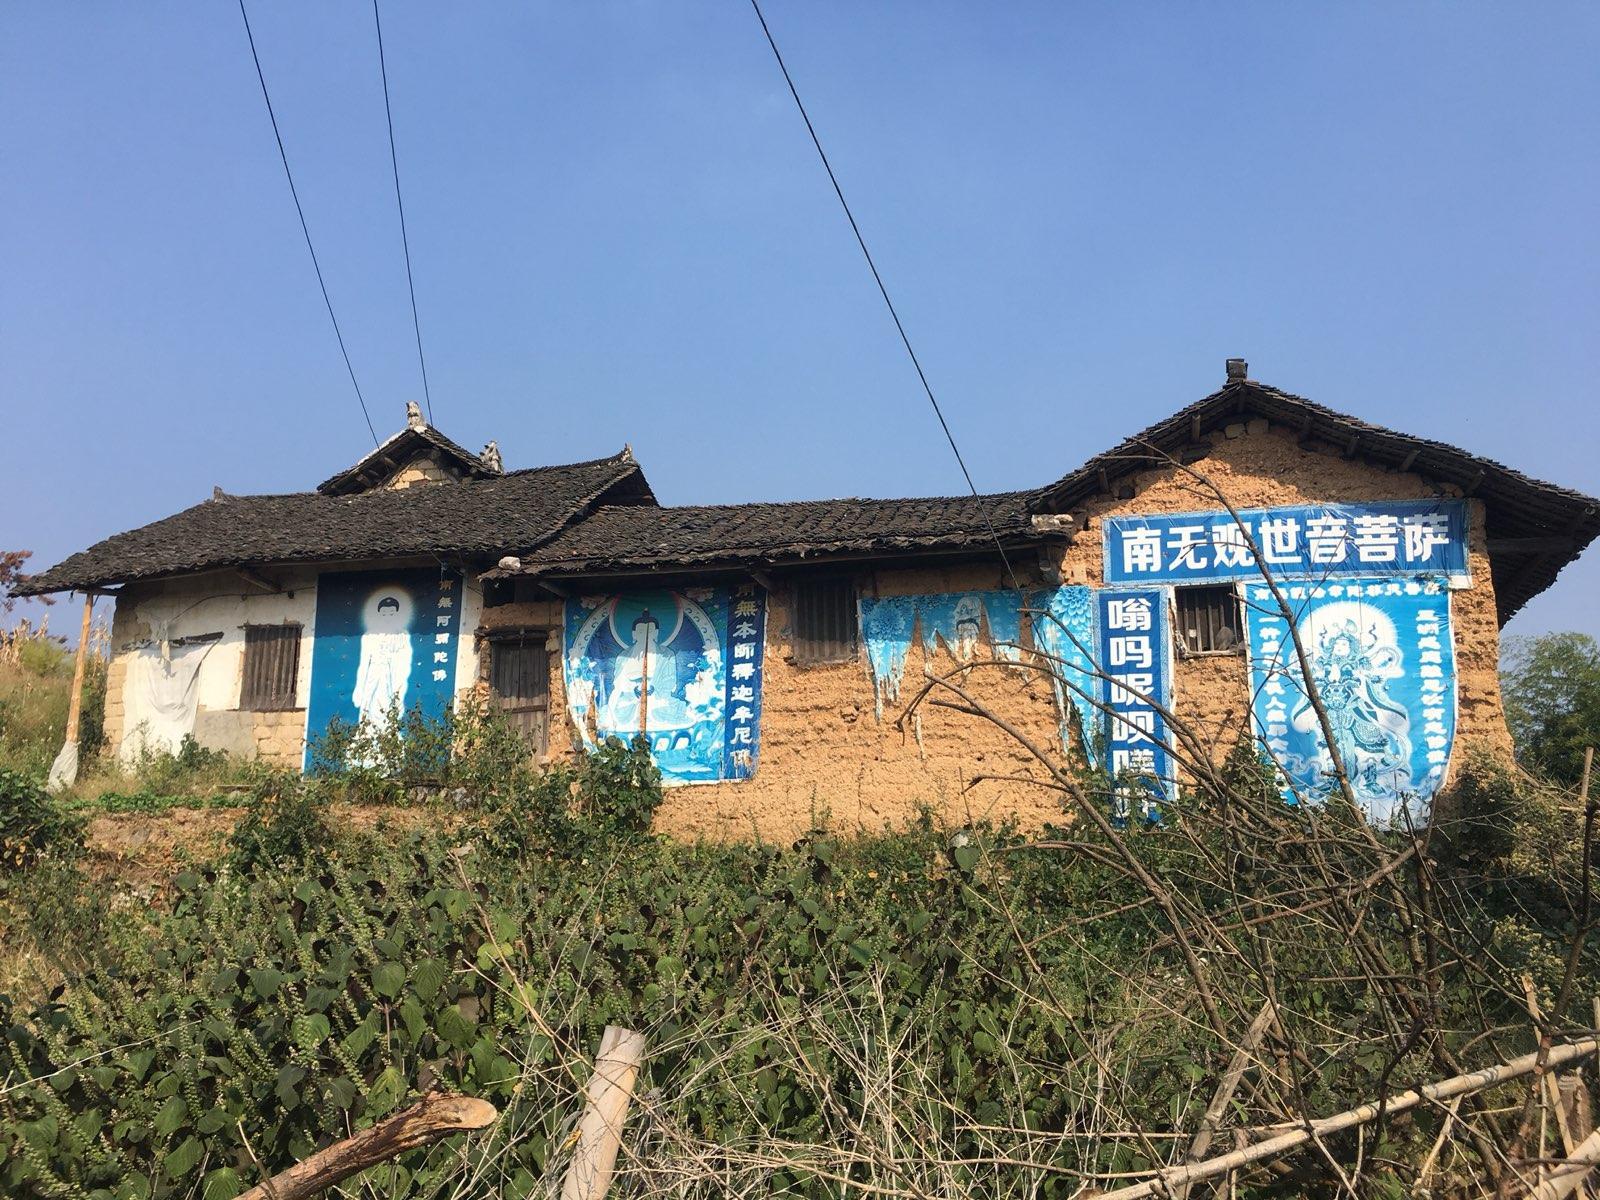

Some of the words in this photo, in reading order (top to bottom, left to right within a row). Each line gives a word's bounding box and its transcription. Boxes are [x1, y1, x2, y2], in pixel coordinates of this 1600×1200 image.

[1121, 513, 1449, 573] 南无观世音菩萨
